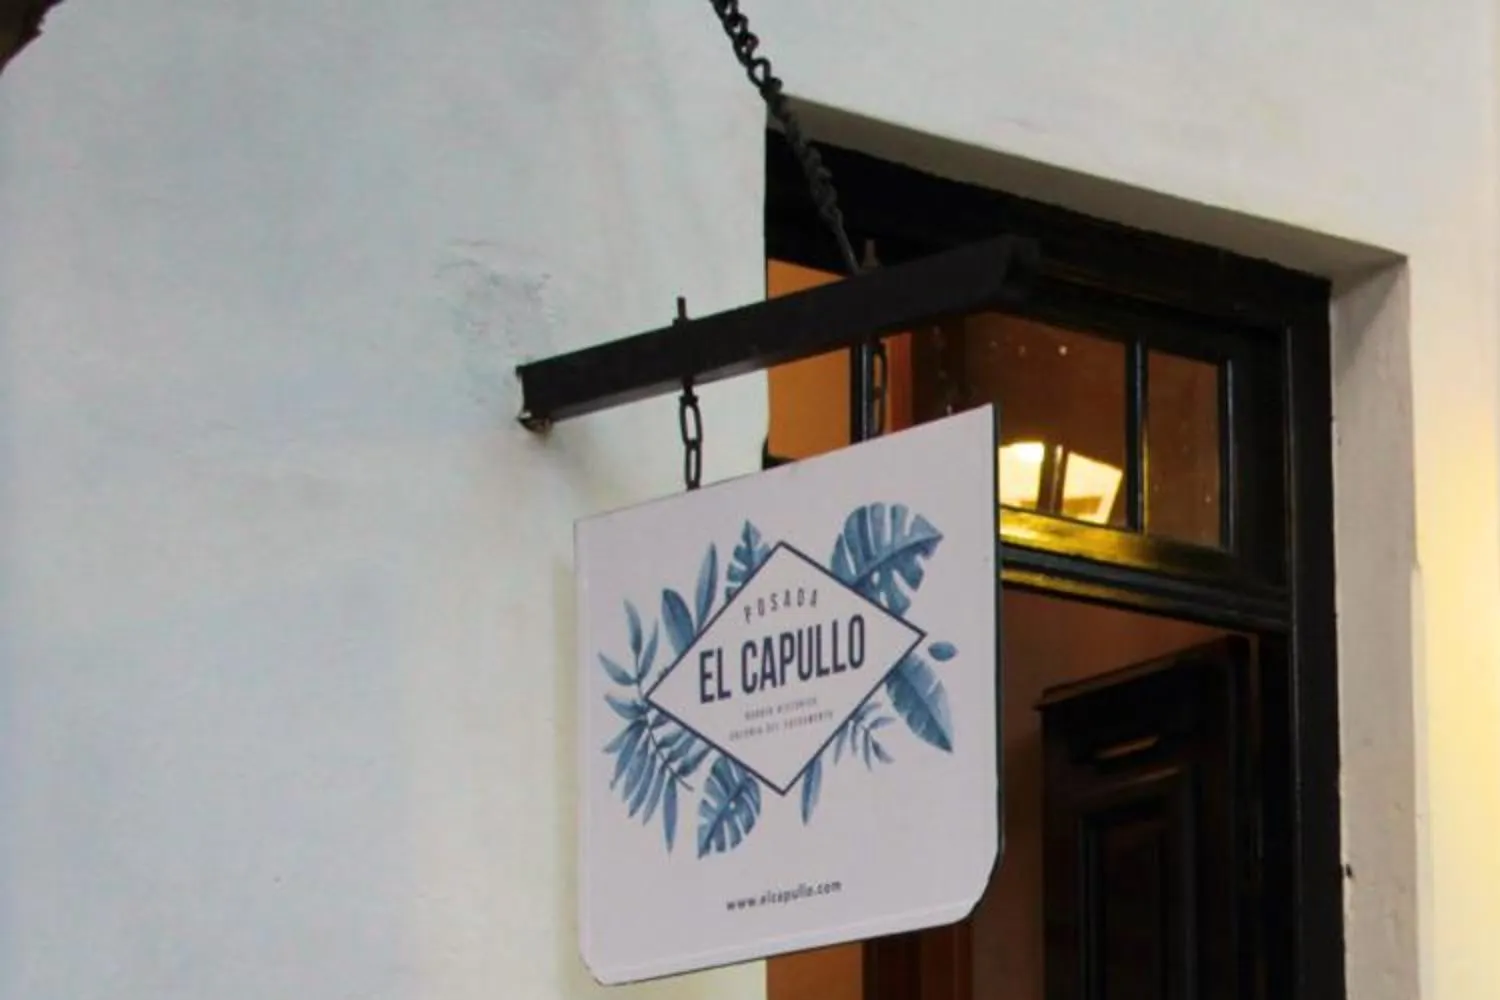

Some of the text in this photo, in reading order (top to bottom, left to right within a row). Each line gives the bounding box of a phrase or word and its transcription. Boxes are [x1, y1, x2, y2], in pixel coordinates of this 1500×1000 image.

[743, 586, 818, 624] POSADA
[699, 613, 865, 704] EL CAPULLO
